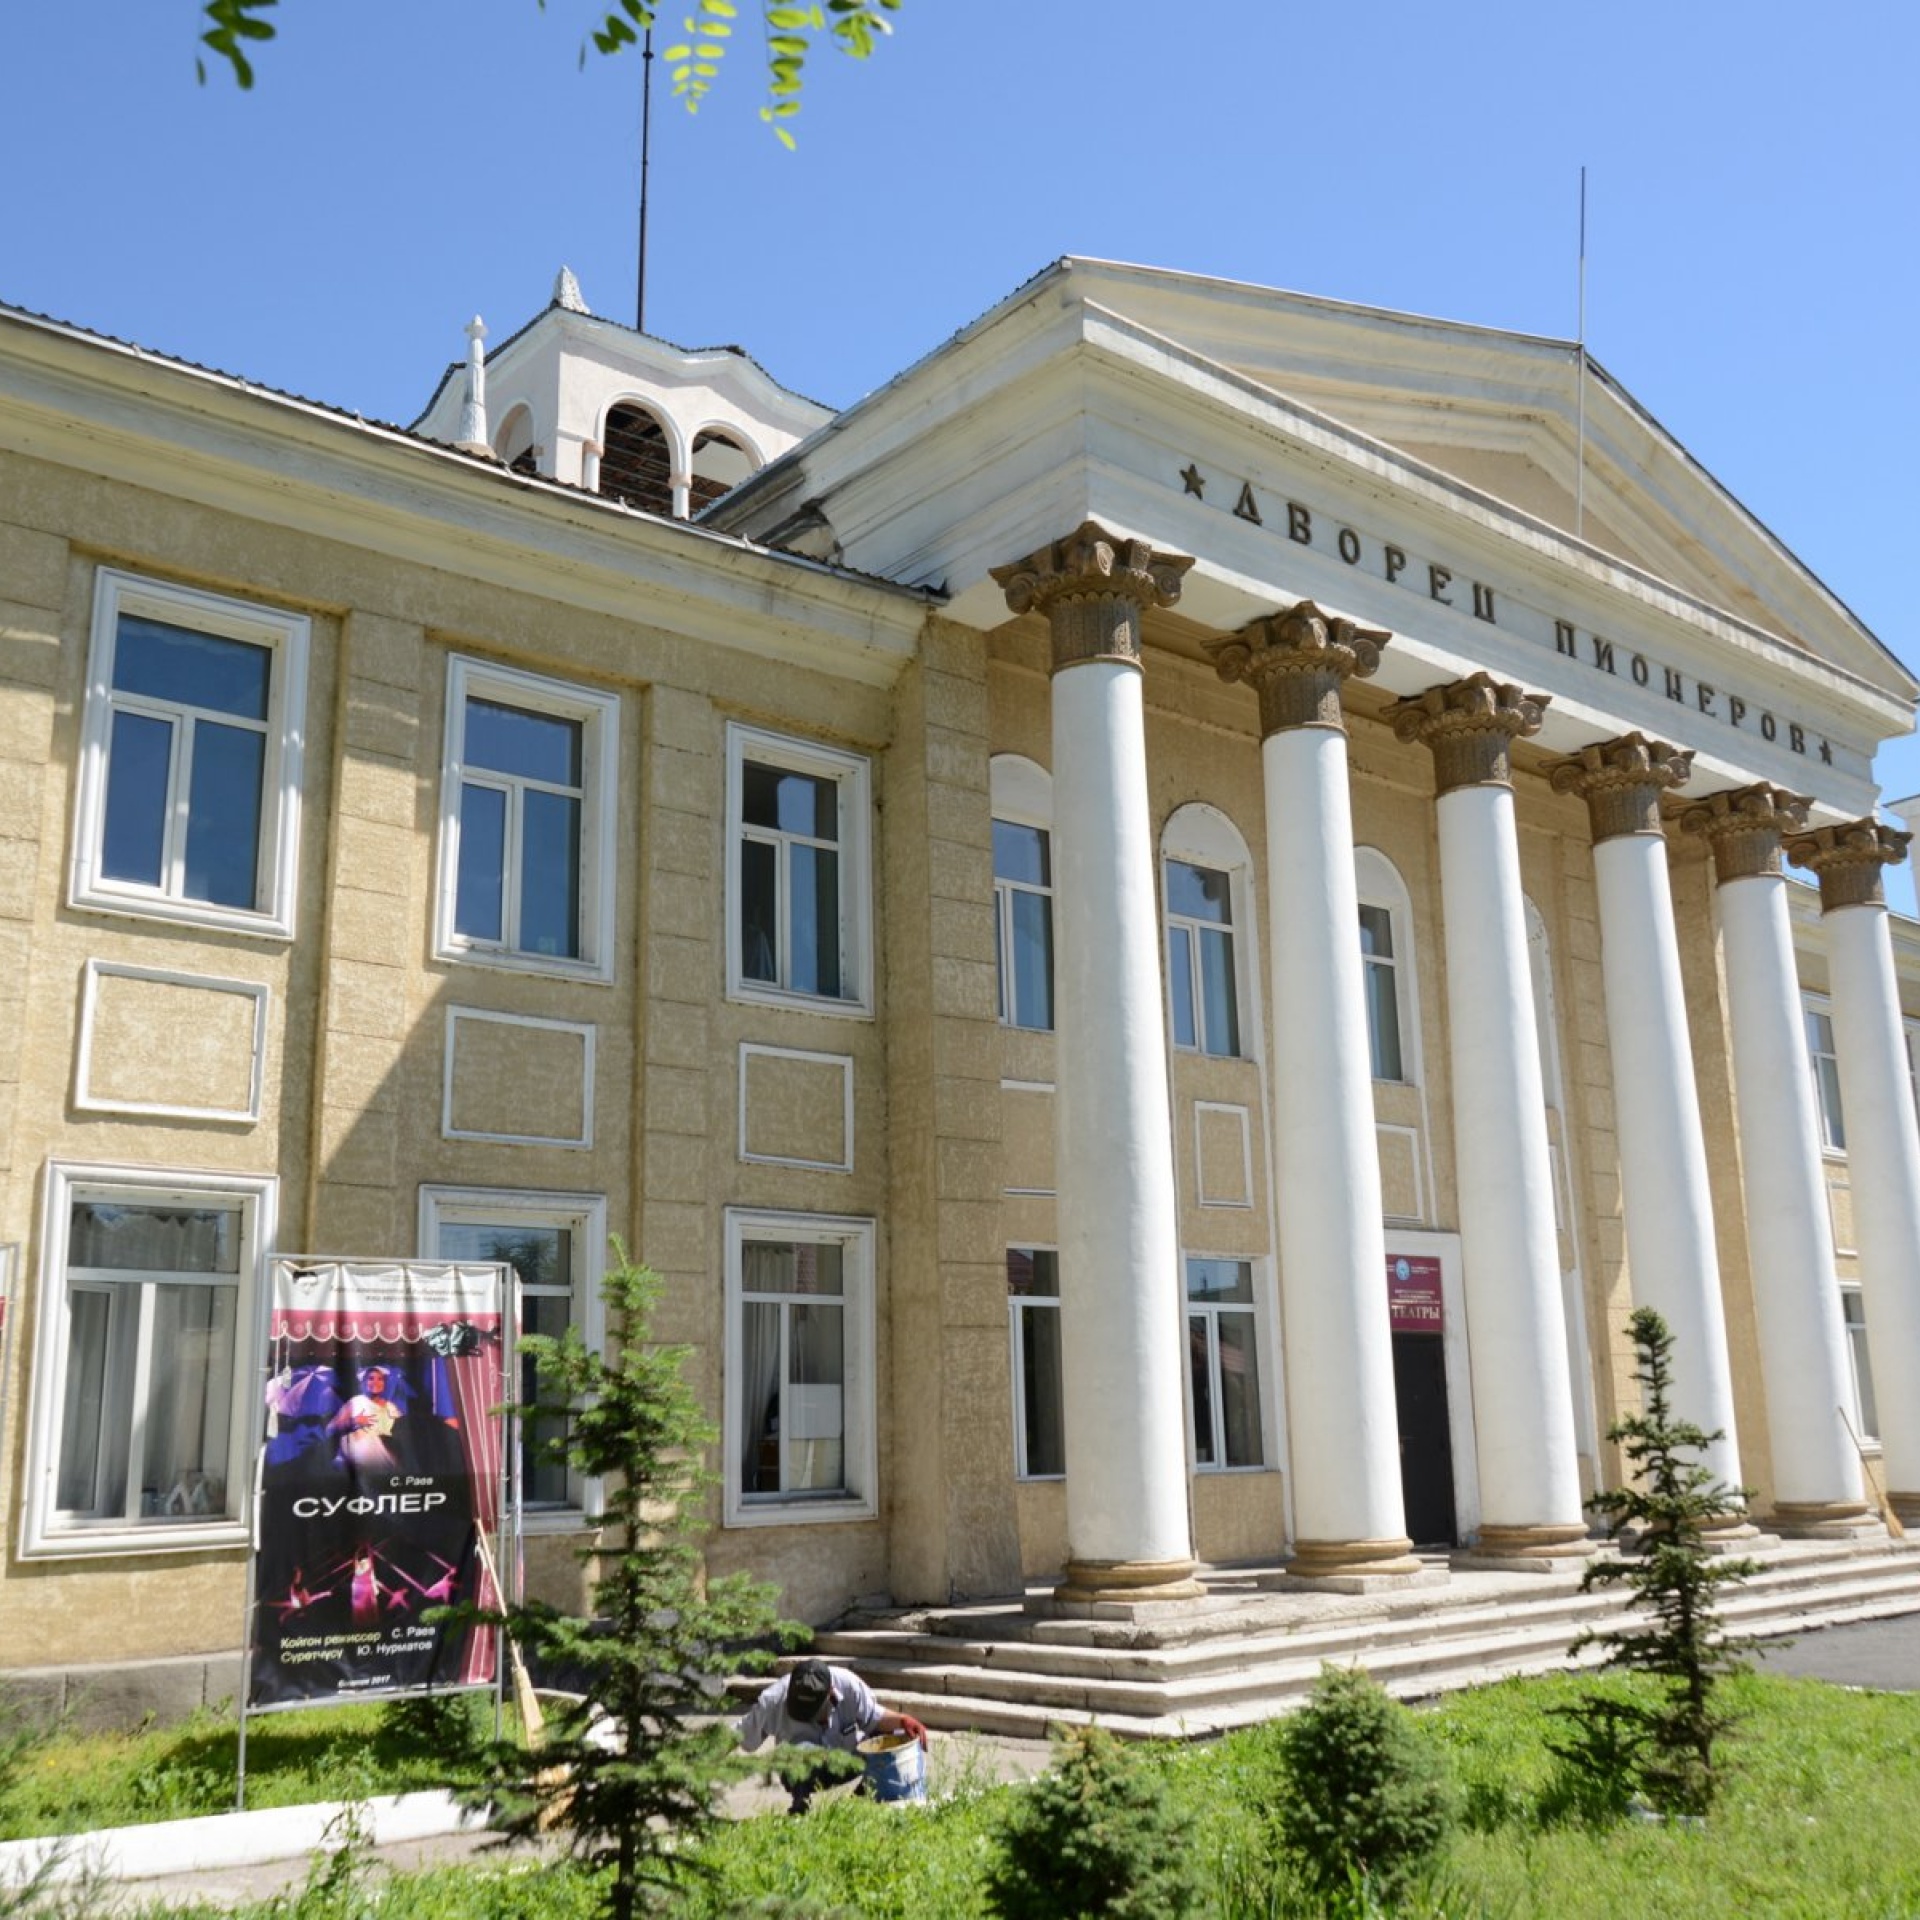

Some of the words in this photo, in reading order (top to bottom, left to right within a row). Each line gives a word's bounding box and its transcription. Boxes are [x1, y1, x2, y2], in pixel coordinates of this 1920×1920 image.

[1233, 481, 1496, 624] ДВОРЕЦ
[1554, 620, 1806, 755] ПИОНЕРОВ
[389, 1476, 402, 1487] С.
[405, 1476, 434, 1486] Раев
[292, 1492, 447, 1518] СУФЛЕР
[391, 1627, 404, 1639] С.
[406, 1625, 436, 1637] Раев
[376, 1640, 433, 1655] Нурматов
